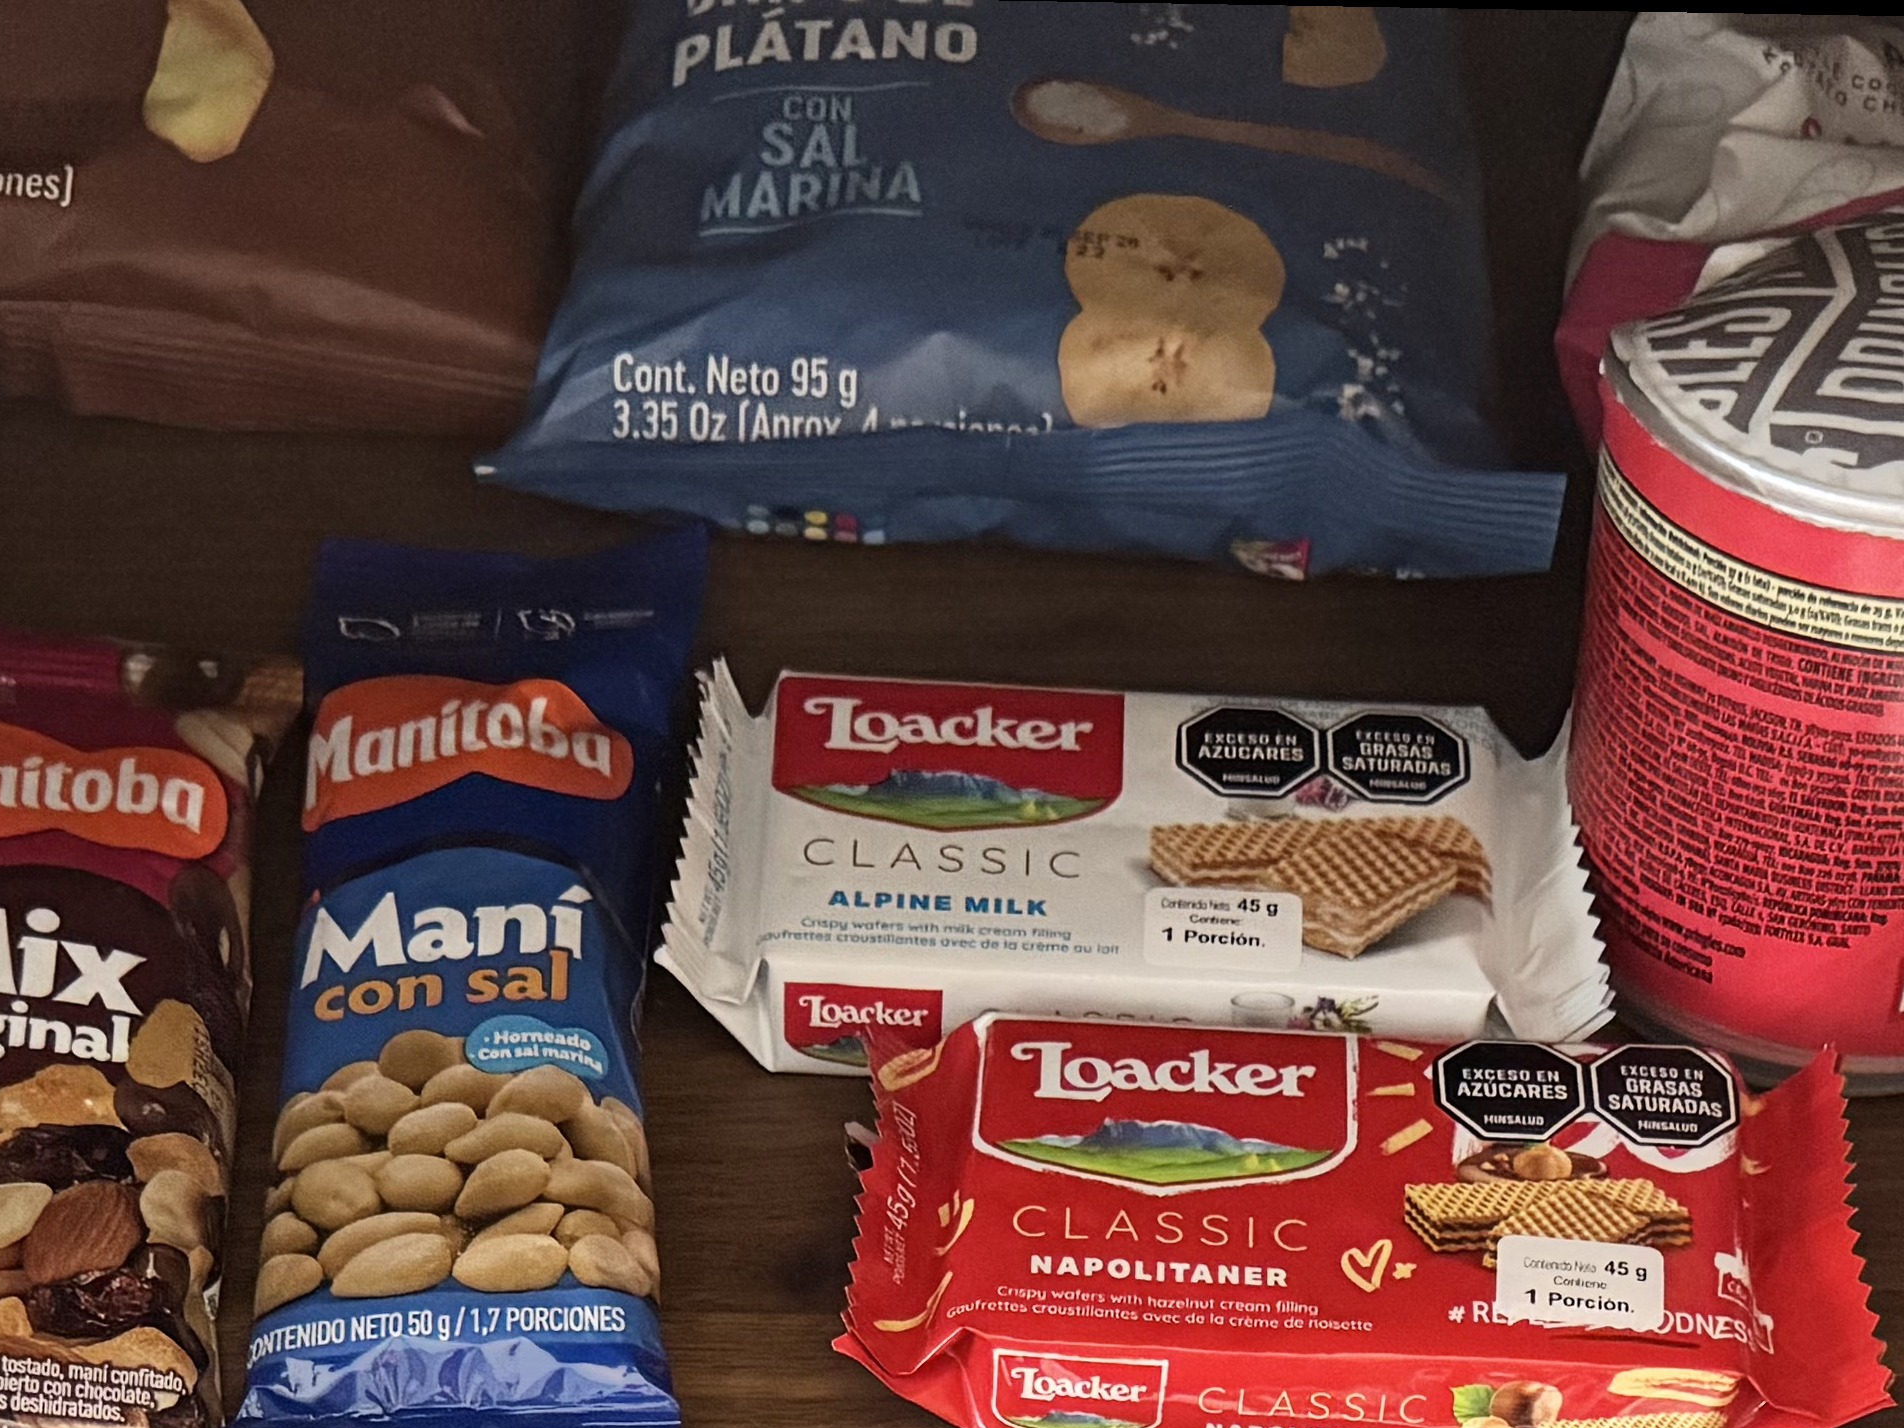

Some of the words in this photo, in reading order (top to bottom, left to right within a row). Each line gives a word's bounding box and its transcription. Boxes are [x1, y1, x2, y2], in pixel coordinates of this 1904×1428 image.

[672, 8, 978, 89] PLÁTANO
[783, 97, 852, 123] CON
[761, 122, 868, 169] SAL
[700, 161, 922, 222] MARINA
[613, 352, 696, 395] Cont.
[707, 355, 779, 396] Neto
[791, 357, 829, 398] 95
[840, 368, 858, 408] g
[612, 399, 678, 440] 3.35
[689, 402, 728, 442] Oz
[1799, 659, 1853, 682] CONTIENE
[802, 694, 1093, 756] Loacker
[1204, 732, 1269, 746] EXCESO
[1275, 733, 1297, 747] EN
[1355, 730, 1410, 743] EXCESO
[304, 696, 612, 811] Manitoba
[1359, 742, 1434, 760] GRASAS
[1342, 756, 1453, 777] SATURADAS
[803, 838, 1082, 880] CLASSIC
[828, 889, 953, 912] ALPINE
[965, 896, 1049, 917] MILK
[1237, 898, 1261, 913] 45
[1266, 903, 1279, 917] g
[300, 885, 594, 990] Maní
[801, 917, 849, 933] Crispy
[852, 918, 904, 932] wafers
[907, 921, 940, 934] with
[943, 923, 974, 935] milk
[978, 926, 1027, 937] cream
[1031, 927, 1072, 941] filling
[836, 931, 937, 948] croustillantes
[941, 937, 977, 948] avec
[980, 939, 1000, 950] de
[1162, 927, 1173, 942] 1
[1184, 930, 1266, 948] Porción.
[313, 974, 442, 1022] con
[467, 949, 569, 1004] sal
[798, 995, 929, 1029] Loacker
[494, 1029, 593, 1053] Horneado
[477, 1045, 511, 1062] Con
[514, 1042, 543, 1060] sal
[543, 1047, 603, 1073] marina
[1010, 1039, 1317, 1102] Loacker
[1462, 1068, 1530, 1082] EXCESO
[1537, 1069, 1560, 1083] EN
[1620, 1065, 1678, 1079] EXCESO
[1684, 1068, 1704, 1081] EN
[1626, 1078, 1703, 1098] GRASAS
[1608, 1094, 1723, 1118] SATURADAS
[1012, 1205, 1308, 1251] CLASSIC
[1029, 1254, 1288, 1288] NAPOLITANER
[1604, 1260, 1629, 1276] 45
[1635, 1266, 1648, 1282] g
[996, 1284, 1047, 1301] Crispy
[1051, 1288, 1105, 1304] wafers
[1110, 1292, 1143, 1306] with
[1147, 1294, 1215, 1310] hazelnut
[1220, 1299, 1271, 1313] cream
[1275, 1299, 1319, 1316] filling
[1524, 1288, 1536, 1305] 1
[1549, 1291, 1635, 1314] Porción.
[1032, 1302, 1138, 1321] croustillantes
[1143, 1312, 1182, 1324] avec
[1184, 1312, 1205, 1325] de
[1209, 1313, 1225, 1326] la
[1227, 1313, 1280, 1328] crème
[1284, 1315, 1304, 1329] de
[1307, 1317, 1373, 1331] noisette
[245, 1316, 345, 1370] CONTENIDO
[349, 1313, 403, 1341] NETO
[407, 1309, 433, 1336] 50
[437, 1317, 452, 1341] g
[454, 1307, 467, 1335] /
[470, 1307, 499, 1338] 1,7
[505, 1305, 626, 1333] PORCIONES
[1, 1358, 64, 1380] tostado,
[68, 1364, 107, 1384] maní
[110, 1368, 186, 1395] confitado,
[11, 1390, 126, 1423] deshidratados.
[42, 1380, 72, 1397] con
[74, 1382, 156, 1409] chocolate,
[1011, 1368, 1147, 1403] Loacker
[1198, 1387, 1427, 1423] CLASSIC
